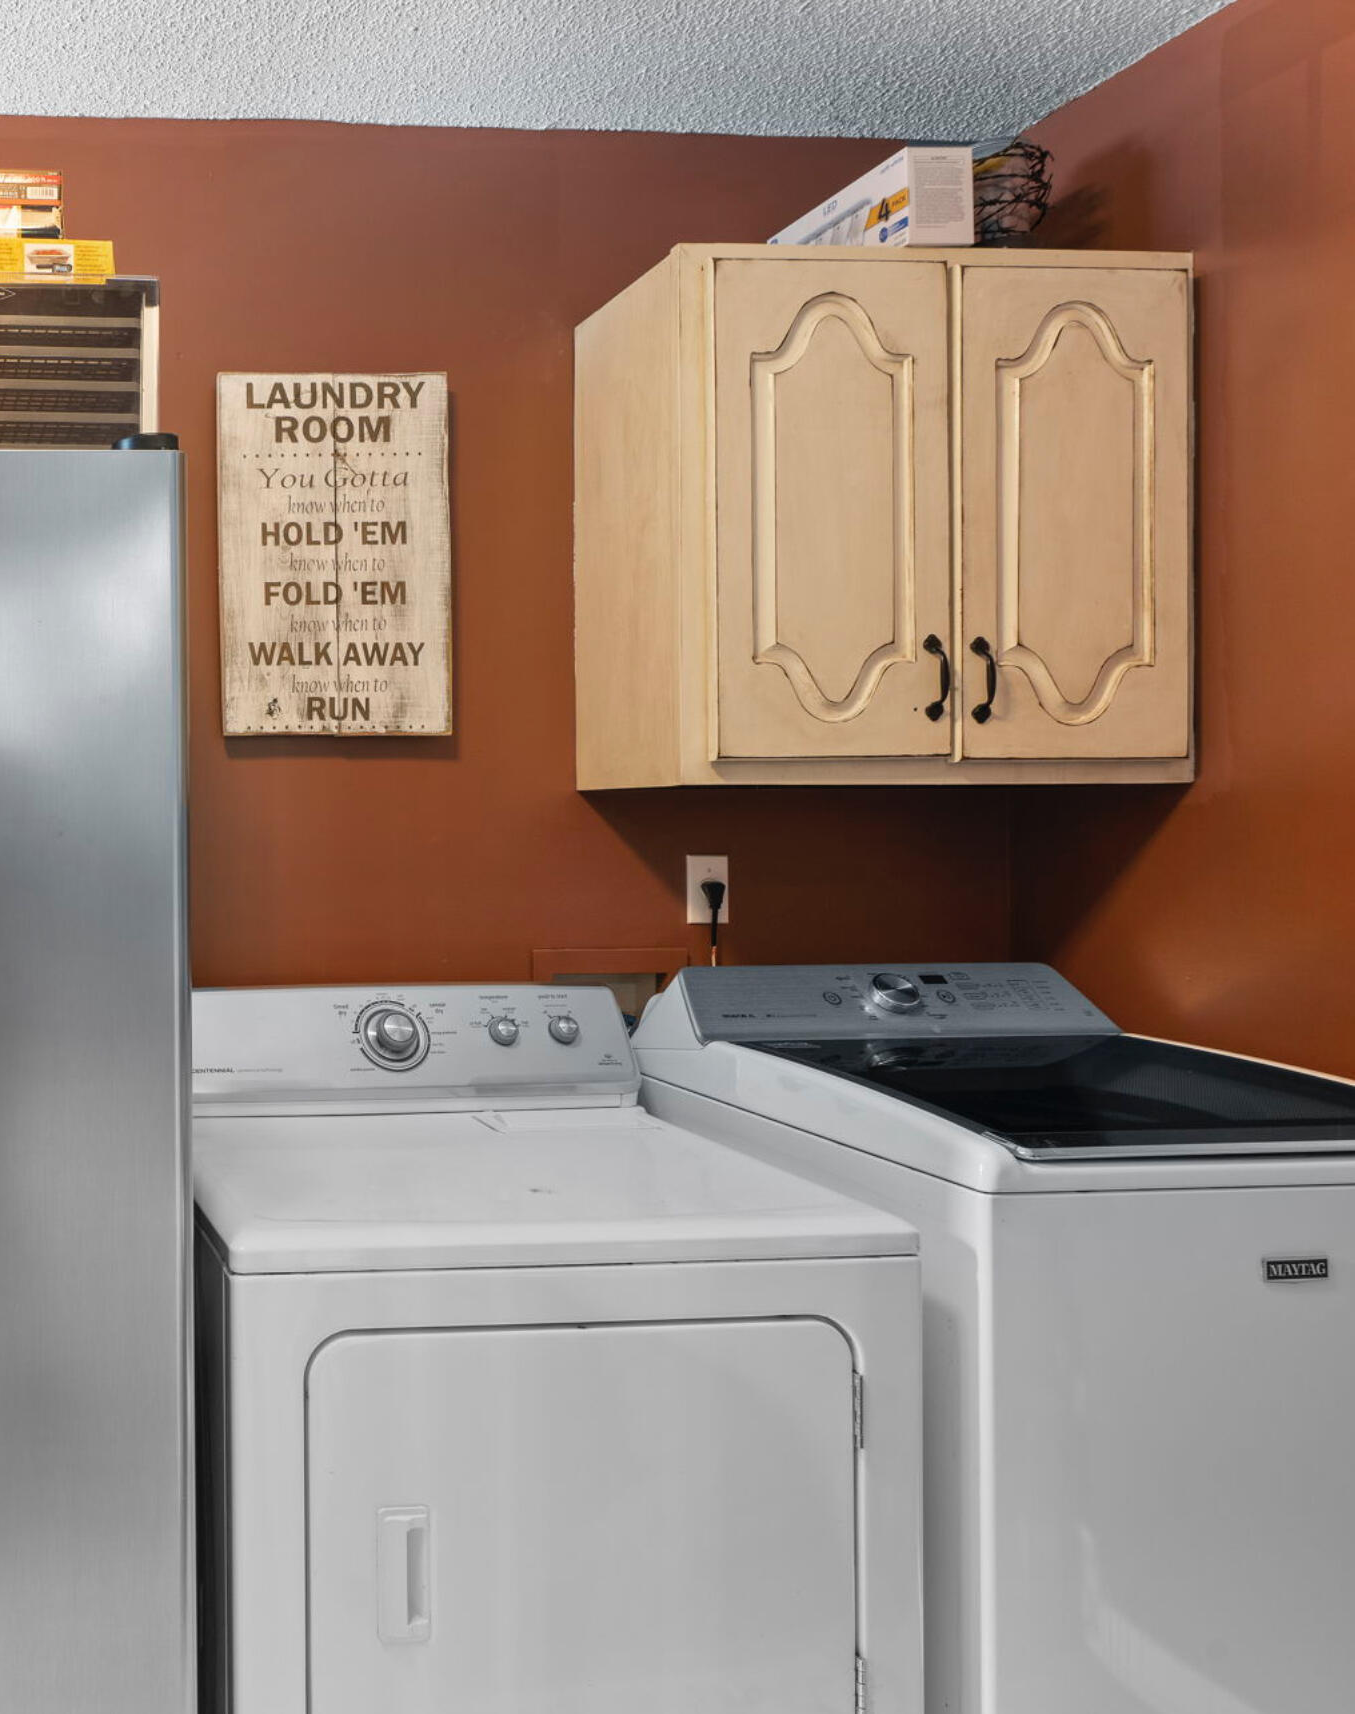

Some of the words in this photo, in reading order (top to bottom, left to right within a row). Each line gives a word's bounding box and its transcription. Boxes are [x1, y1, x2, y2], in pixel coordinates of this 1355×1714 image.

[878, 198, 891, 222] 4
[246, 381, 425, 409] LAUNDRY
[275, 416, 391, 443] ROOM
[257, 467, 315, 489] You
[324, 466, 409, 489] Gotta
[288, 495, 325, 514] know
[329, 493, 368, 513] when
[369, 497, 385, 513] to
[261, 521, 343, 546] HOLD
[354, 520, 407, 545] 'EM
[289, 553, 327, 572] know
[331, 553, 368, 572] when
[370, 556, 385, 572] to
[264, 581, 343, 606] FOLD
[353, 581, 407, 605] 'EM
[290, 615, 328, 633] know
[332, 613, 368, 632] when
[373, 615, 387, 631] to
[248, 641, 333, 667] WALK
[342, 642, 425, 667] AWAY
[292, 676, 330, 694] know
[333, 675, 370, 693] when
[373, 677, 388, 692] to
[306, 696, 370, 721] RUN
[1269, 1262, 1326, 1277] MAYTAG
